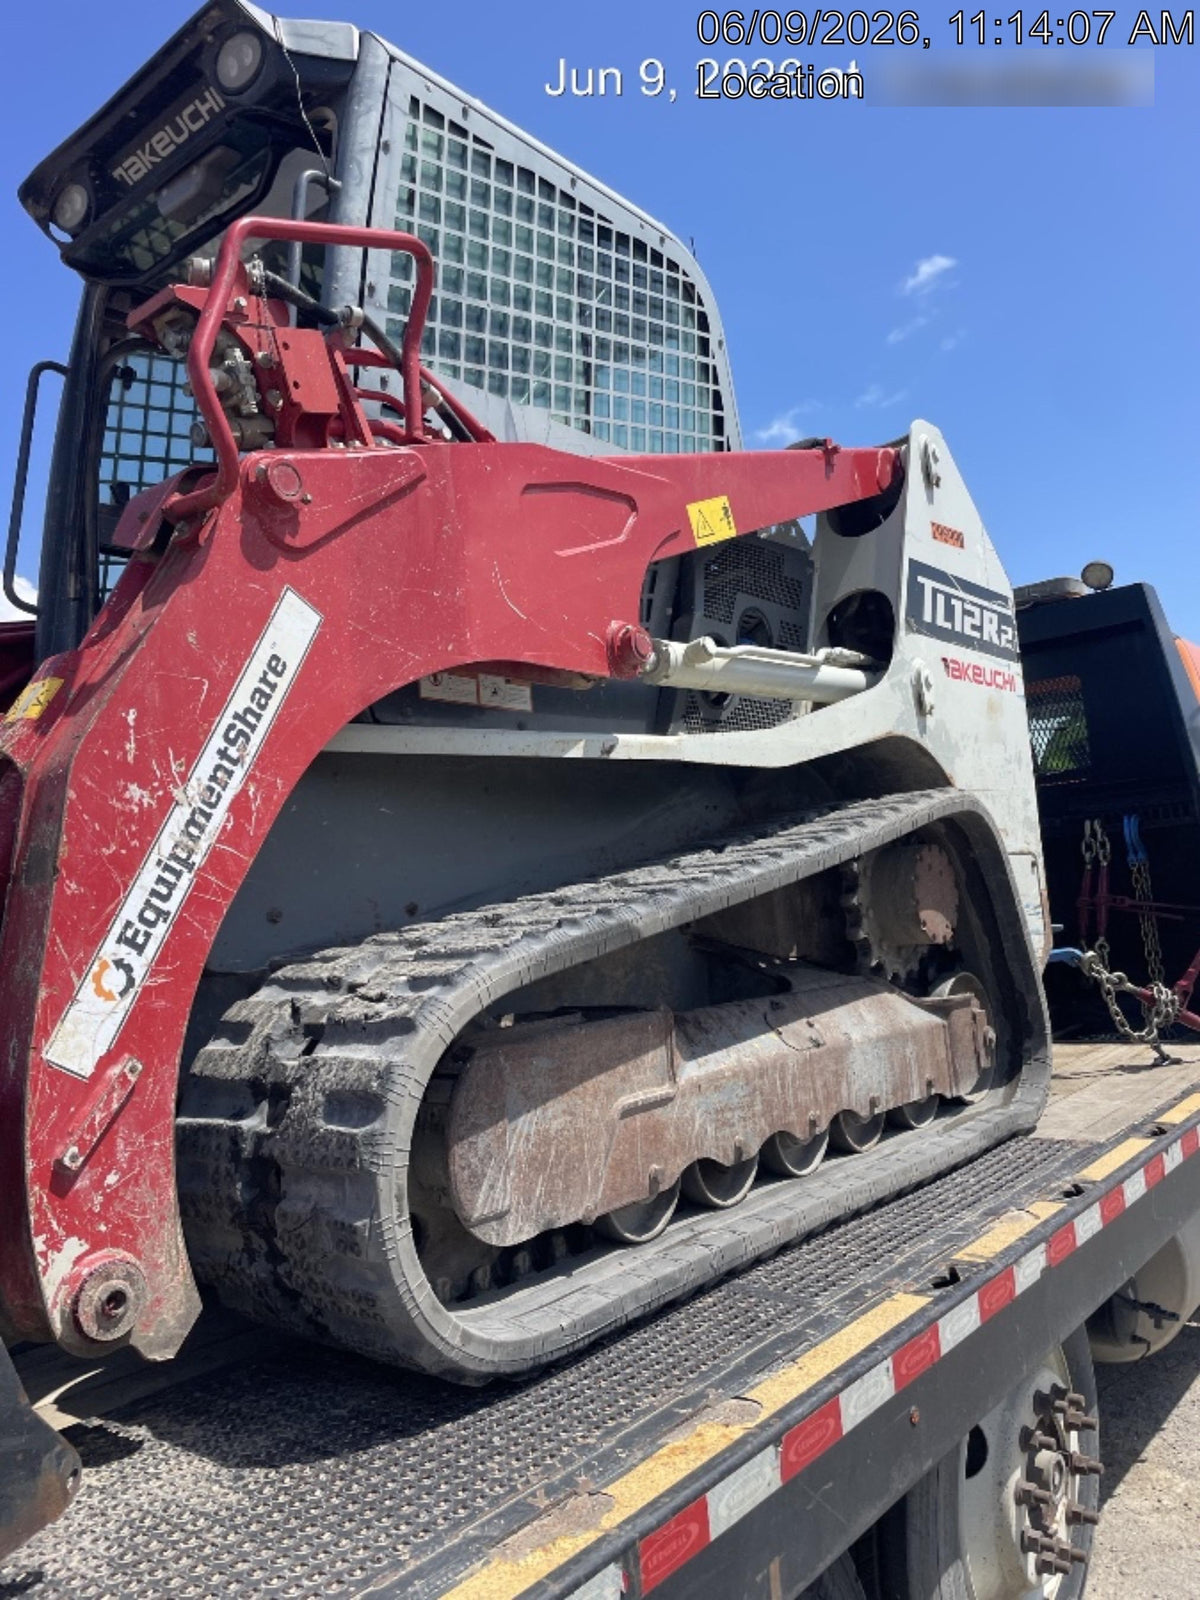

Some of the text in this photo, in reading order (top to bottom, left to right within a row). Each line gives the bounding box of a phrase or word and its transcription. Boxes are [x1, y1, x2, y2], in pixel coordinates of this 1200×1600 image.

[112, 86, 226, 186] TAKEUCHI
[917, 575, 1016, 652] TL12R2
[942, 657, 1016, 692] TAKEUCHI
